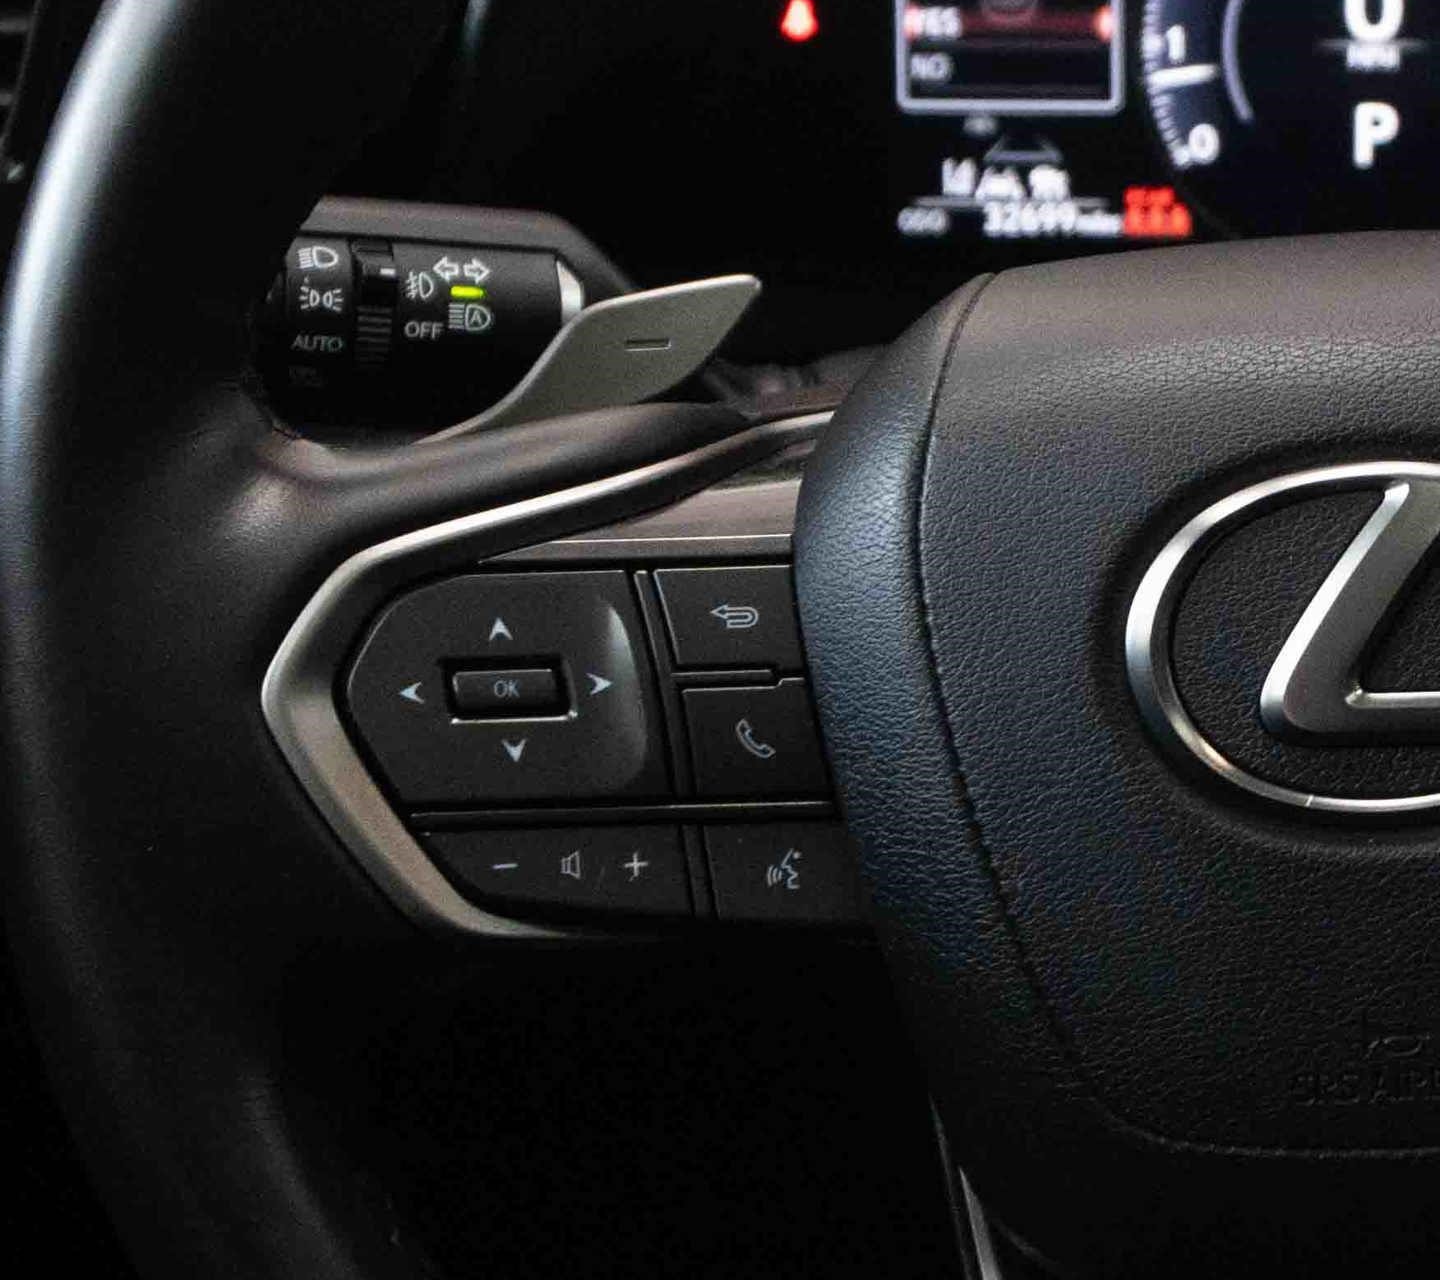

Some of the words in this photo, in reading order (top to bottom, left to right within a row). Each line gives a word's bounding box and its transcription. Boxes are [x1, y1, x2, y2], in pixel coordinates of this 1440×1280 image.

[1165, 24, 1186, 63] 1
[1188, 123, 1220, 164] 0
[1352, 102, 1400, 169] P
[291, 333, 344, 353] AUTO
[404, 320, 444, 340] OFF
[493, 678, 521, 700] OK
